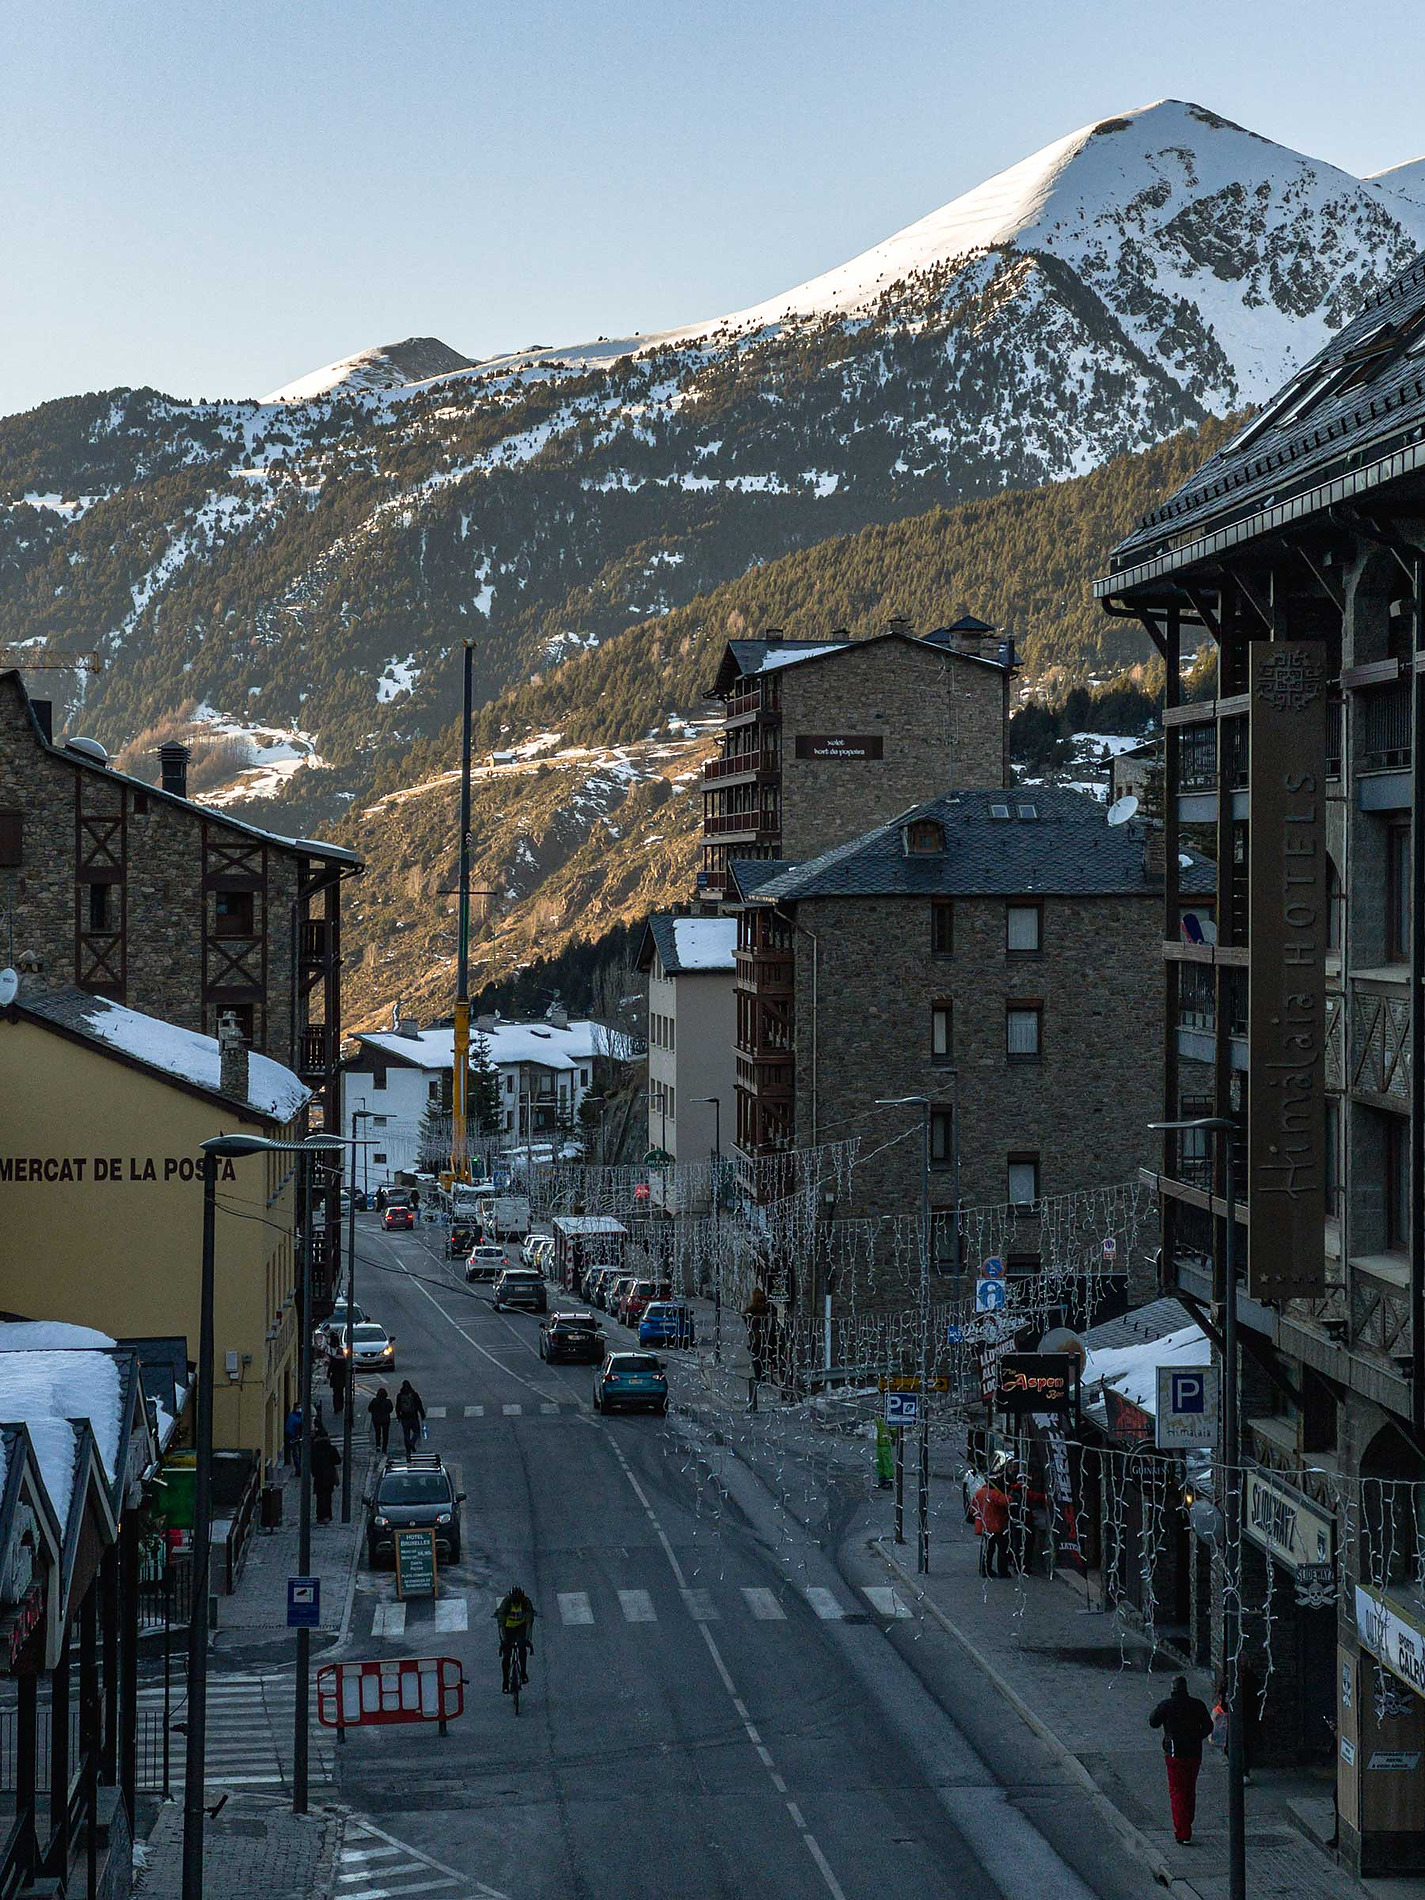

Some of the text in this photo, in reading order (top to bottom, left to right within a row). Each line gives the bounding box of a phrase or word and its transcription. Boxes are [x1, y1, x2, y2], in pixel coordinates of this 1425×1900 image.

[1283, 772, 1317, 966] HOTELS
[0, 1158, 86, 1182] MERCAT
[94, 1158, 122, 1181] DE
[130, 1158, 157, 1181] LA
[1001, 1374, 1064, 1392] Aspen
[1177, 1379, 1200, 1409] P
[887, 1395, 902, 1415] P
